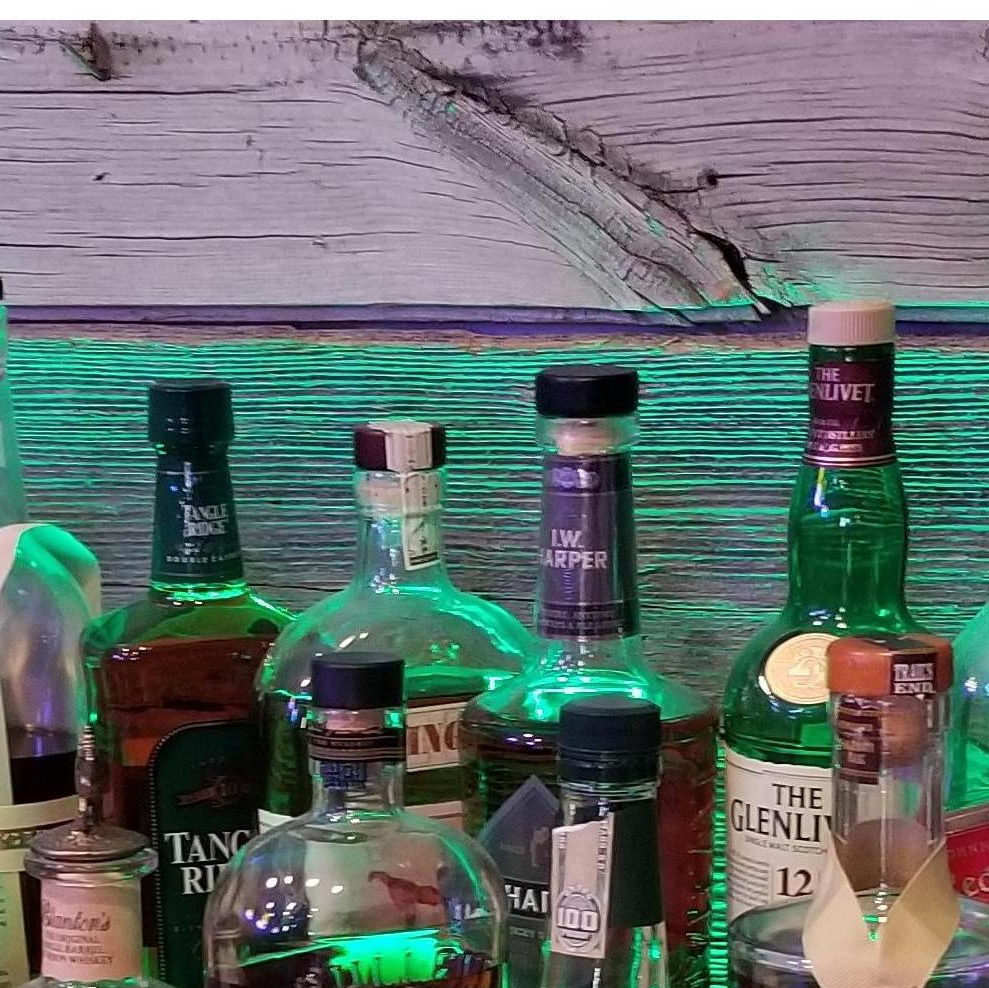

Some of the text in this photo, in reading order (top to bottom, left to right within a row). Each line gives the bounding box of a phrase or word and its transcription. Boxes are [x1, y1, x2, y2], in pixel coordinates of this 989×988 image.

[546, 550, 608, 569] ARPER
[772, 783, 823, 809] THE
[777, 867, 813, 897] 12
[556, 907, 599, 933] 100
